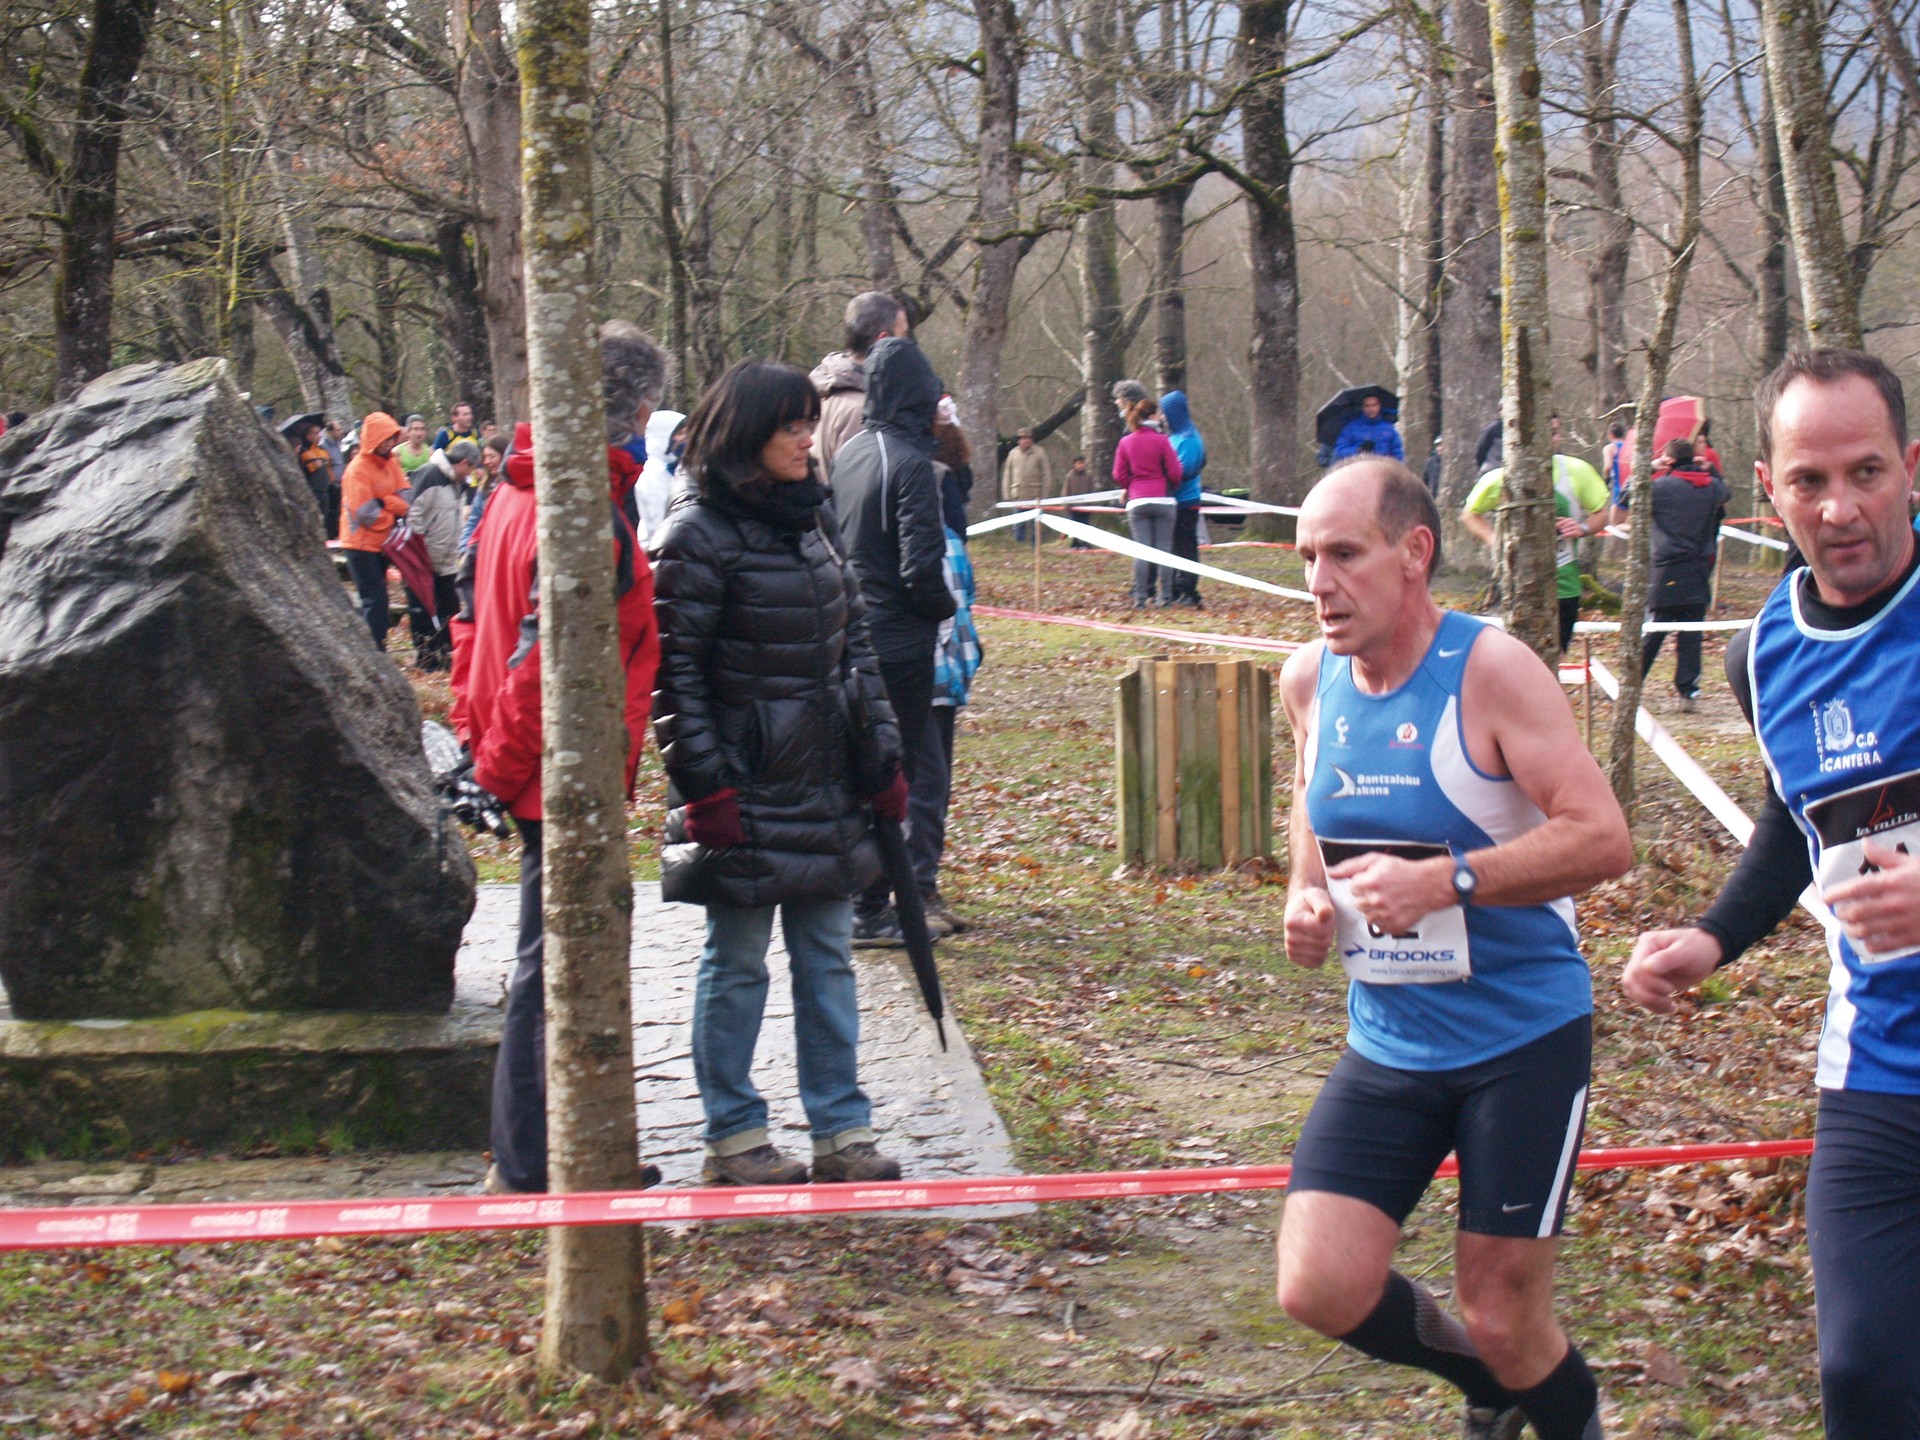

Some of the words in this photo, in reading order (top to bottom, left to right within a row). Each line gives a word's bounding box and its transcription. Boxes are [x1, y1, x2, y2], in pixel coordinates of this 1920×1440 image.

[1855, 733, 1877, 749] C.D.
[1824, 751, 1881, 772] CANTERA
[1369, 949, 1456, 962] BROOKS
